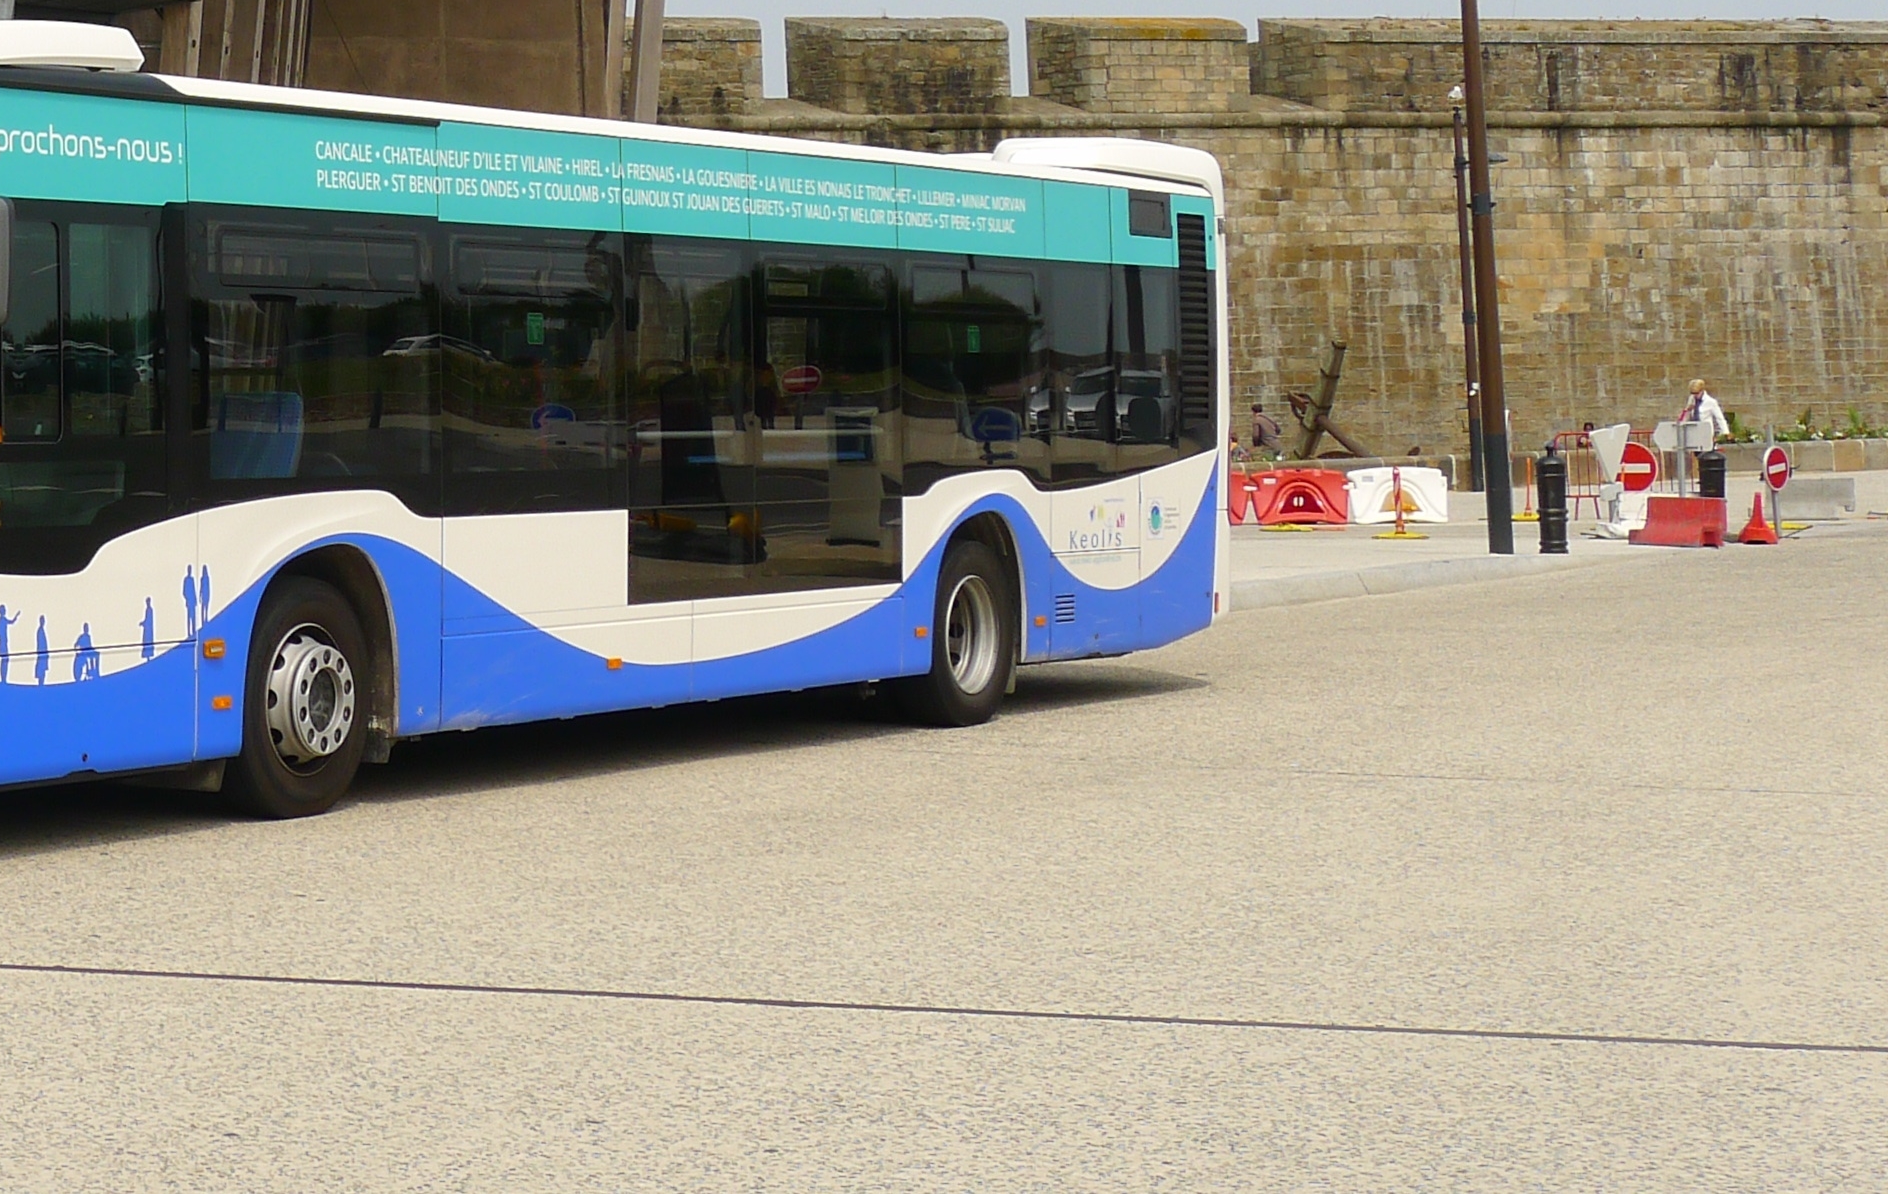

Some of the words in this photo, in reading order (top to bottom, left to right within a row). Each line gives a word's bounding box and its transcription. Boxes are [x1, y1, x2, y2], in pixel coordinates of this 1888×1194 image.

[315, 141, 373, 163] CANCALE
[383, 146, 471, 169] CHATEAUNEUF
[473, 152, 502, 171] D'ILE
[505, 154, 518, 172] ET
[520, 155, 563, 174] VILAINE
[572, 159, 603, 177] HIREL
[612, 162, 625, 179] LA
[627, 163, 674, 183] FRESNAIS
[682, 168, 695, 185] LA
[697, 169, 757, 190] GOUESNIERE
[765, 176, 777, 192] LA
[778, 177, 803, 194] VILLE
[805, 179, 816, 195] ES
[818, 181, 852, 199] NONAIS
[854, 184, 864, 200] LE
[866, 185, 911, 203] TRONCHET
[317, 169, 381, 191] PLERGUER
[392, 174, 406, 192] ST
[409, 175, 453, 195] BENOIT
[456, 177, 478, 196] DES
[480, 179, 519, 198] ONDES
[529, 182, 542, 199] ST
[545, 183, 599, 202] COULOMB
[608, 187, 620, 203] ST
[622, 188, 670, 208] GUINOUX
[672, 192, 685, 209] ST
[686, 193, 719, 211] JOUAN
[722, 196, 740, 213] DES
[742, 198, 784, 217] GUERETS
[792, 202, 803, 218] ST
[804, 204, 831, 220] MALO
[837, 206, 849, 222] ST
[851, 207, 885, 224] MELOIR
[887, 210, 903, 226] DES
[905, 211, 933, 228] ONDES
[939, 214, 949, 229] ST
[951, 214, 971, 231] PERE
[977, 217, 987, 232] ST
[1069, 529, 1122, 550] Keolis
